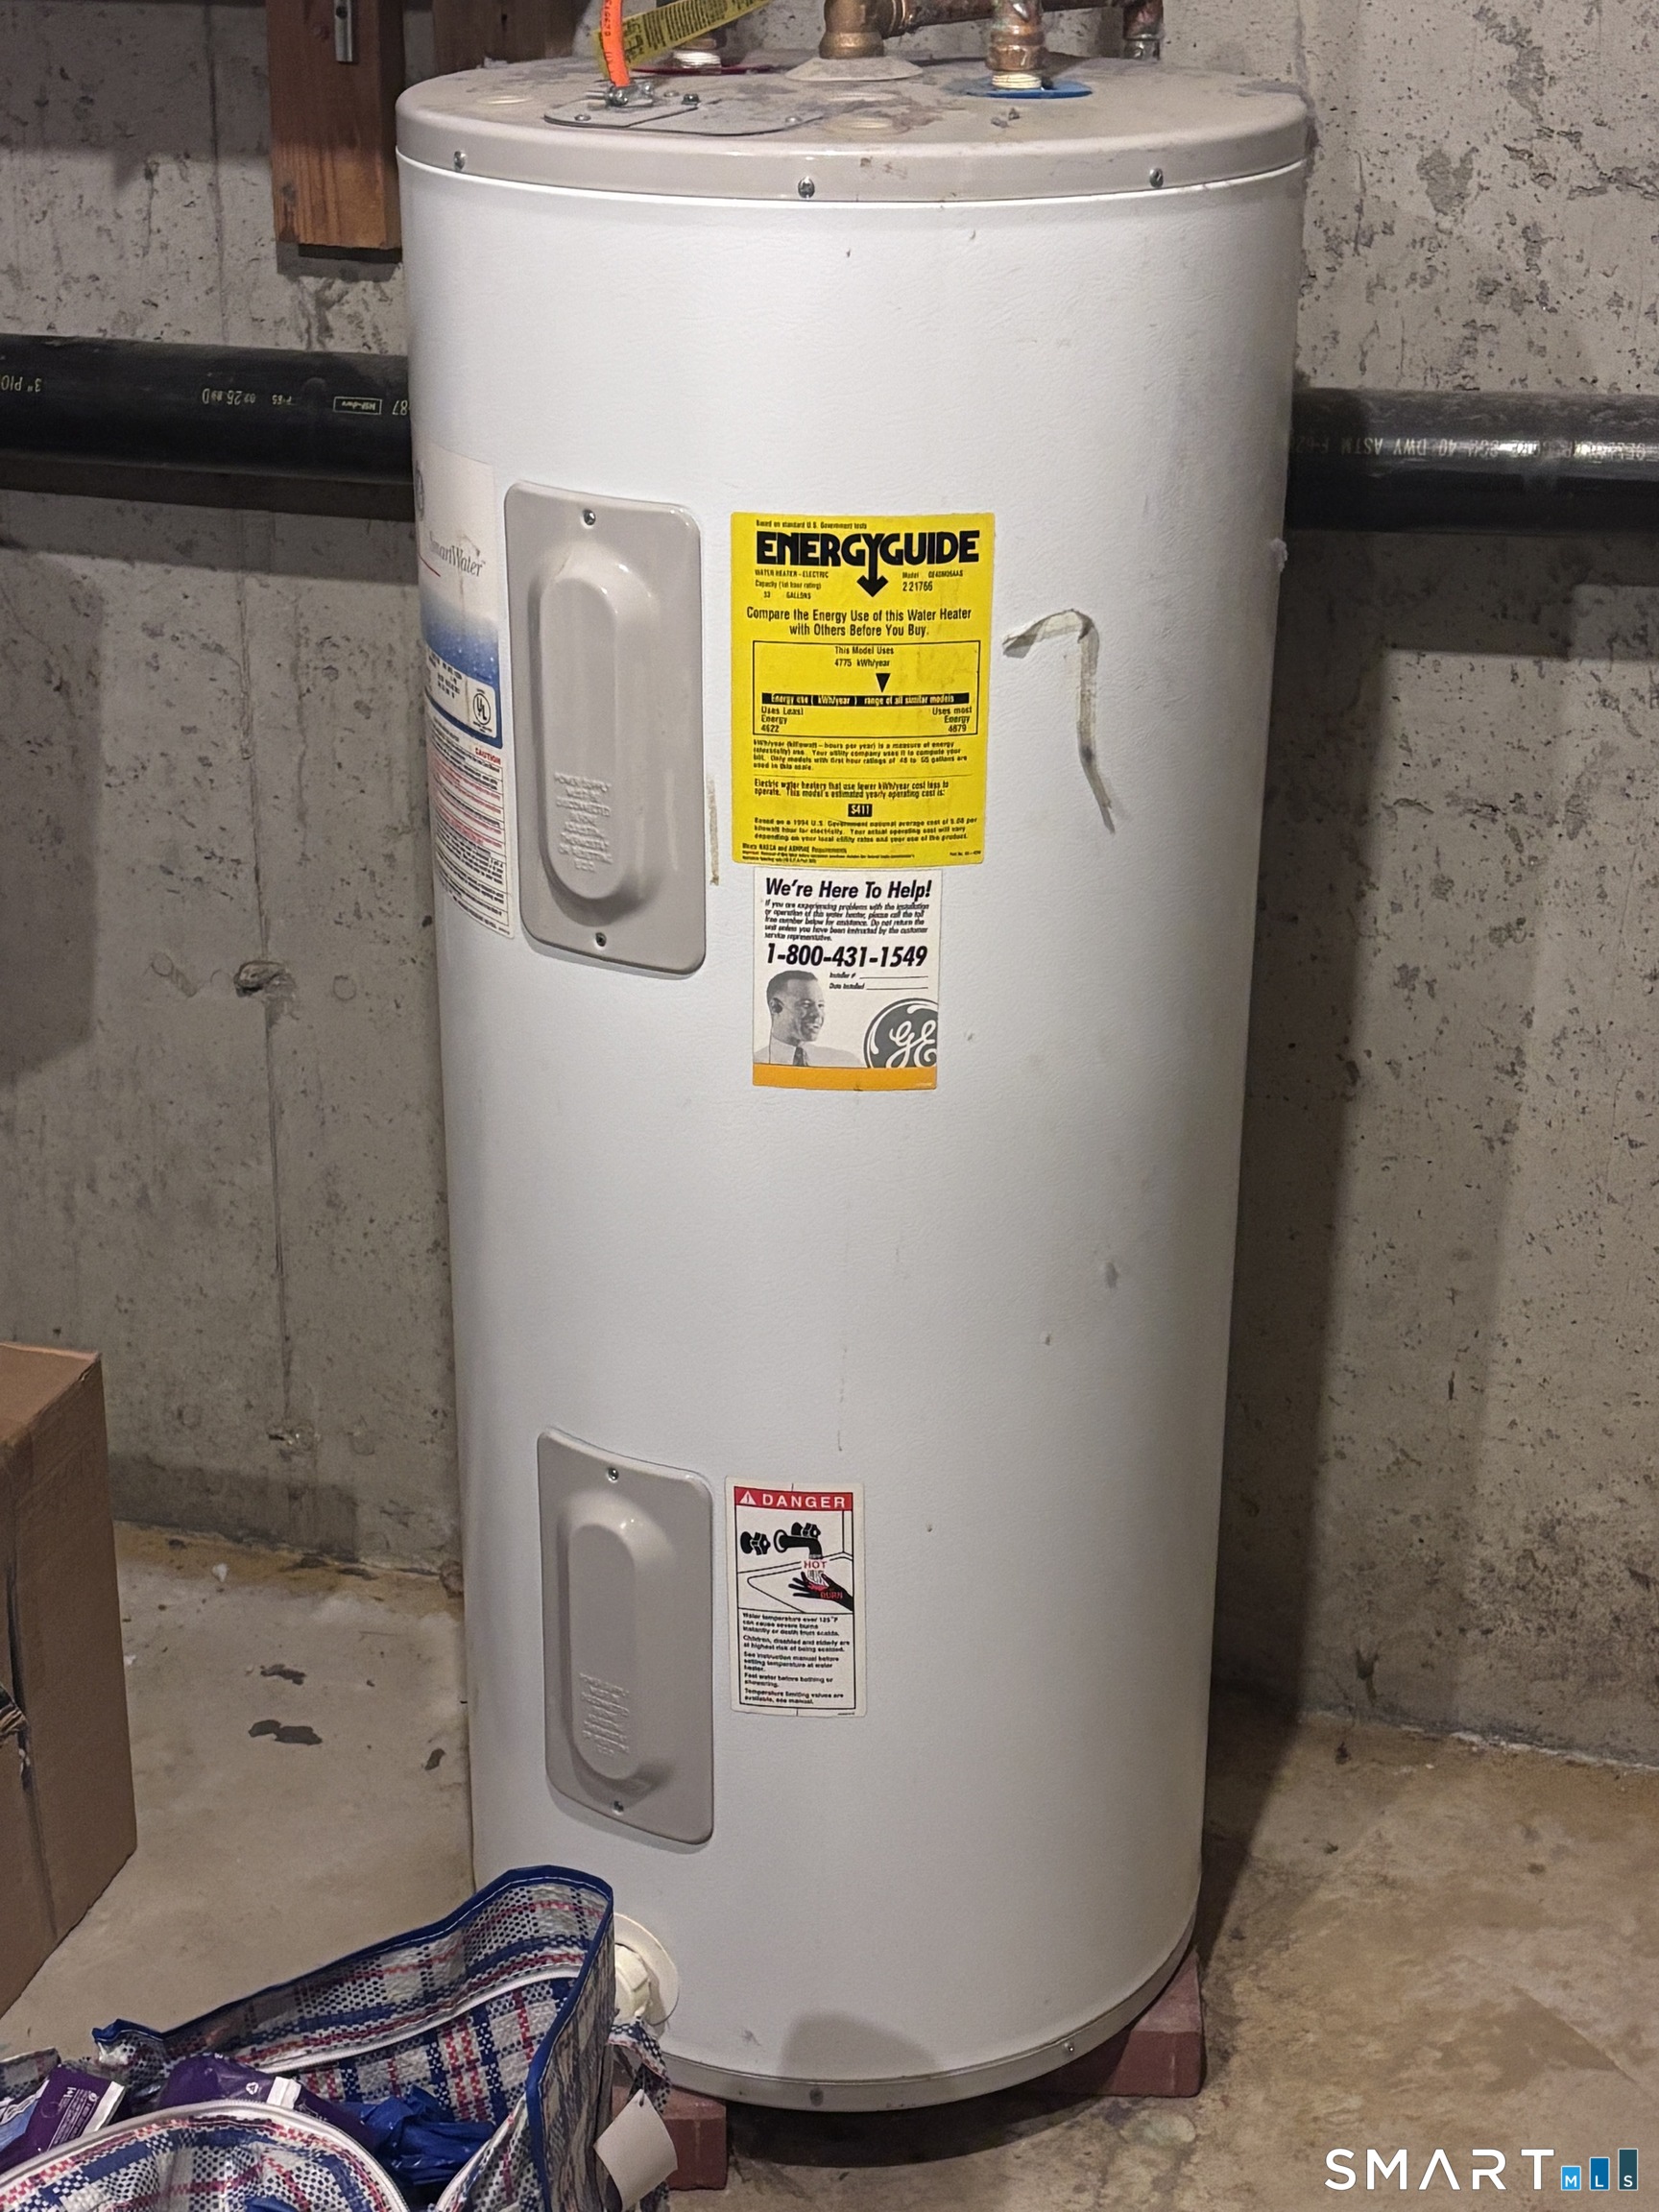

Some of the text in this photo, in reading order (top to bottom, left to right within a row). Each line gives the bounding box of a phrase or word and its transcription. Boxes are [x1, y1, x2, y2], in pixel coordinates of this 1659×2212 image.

[757, 530, 980, 568] ENERGYGUIDE
[756, 580, 777, 589] Capacity
[747, 606, 972, 624] Compare the Energy Use of this Water Heater
[789, 623, 929, 637] with Others Before You Buy.
[857, 659, 890, 668] kWh/year
[771, 694, 794, 705] Energy
[818, 695, 851, 706] kWh/year
[864, 697, 883, 707] range
[886, 696, 892, 705] of
[905, 695, 928, 704] similar
[761, 715, 787, 724] Energy
[949, 724, 967, 733] 4879
[766, 878, 932, 902] We're Here To Help!
[767, 943, 928, 967] 1-800-431-1549
[762, 1493, 846, 1509] DANGER
[804, 1559, 828, 1570] HOT
[820, 1591, 844, 1599] BURN
